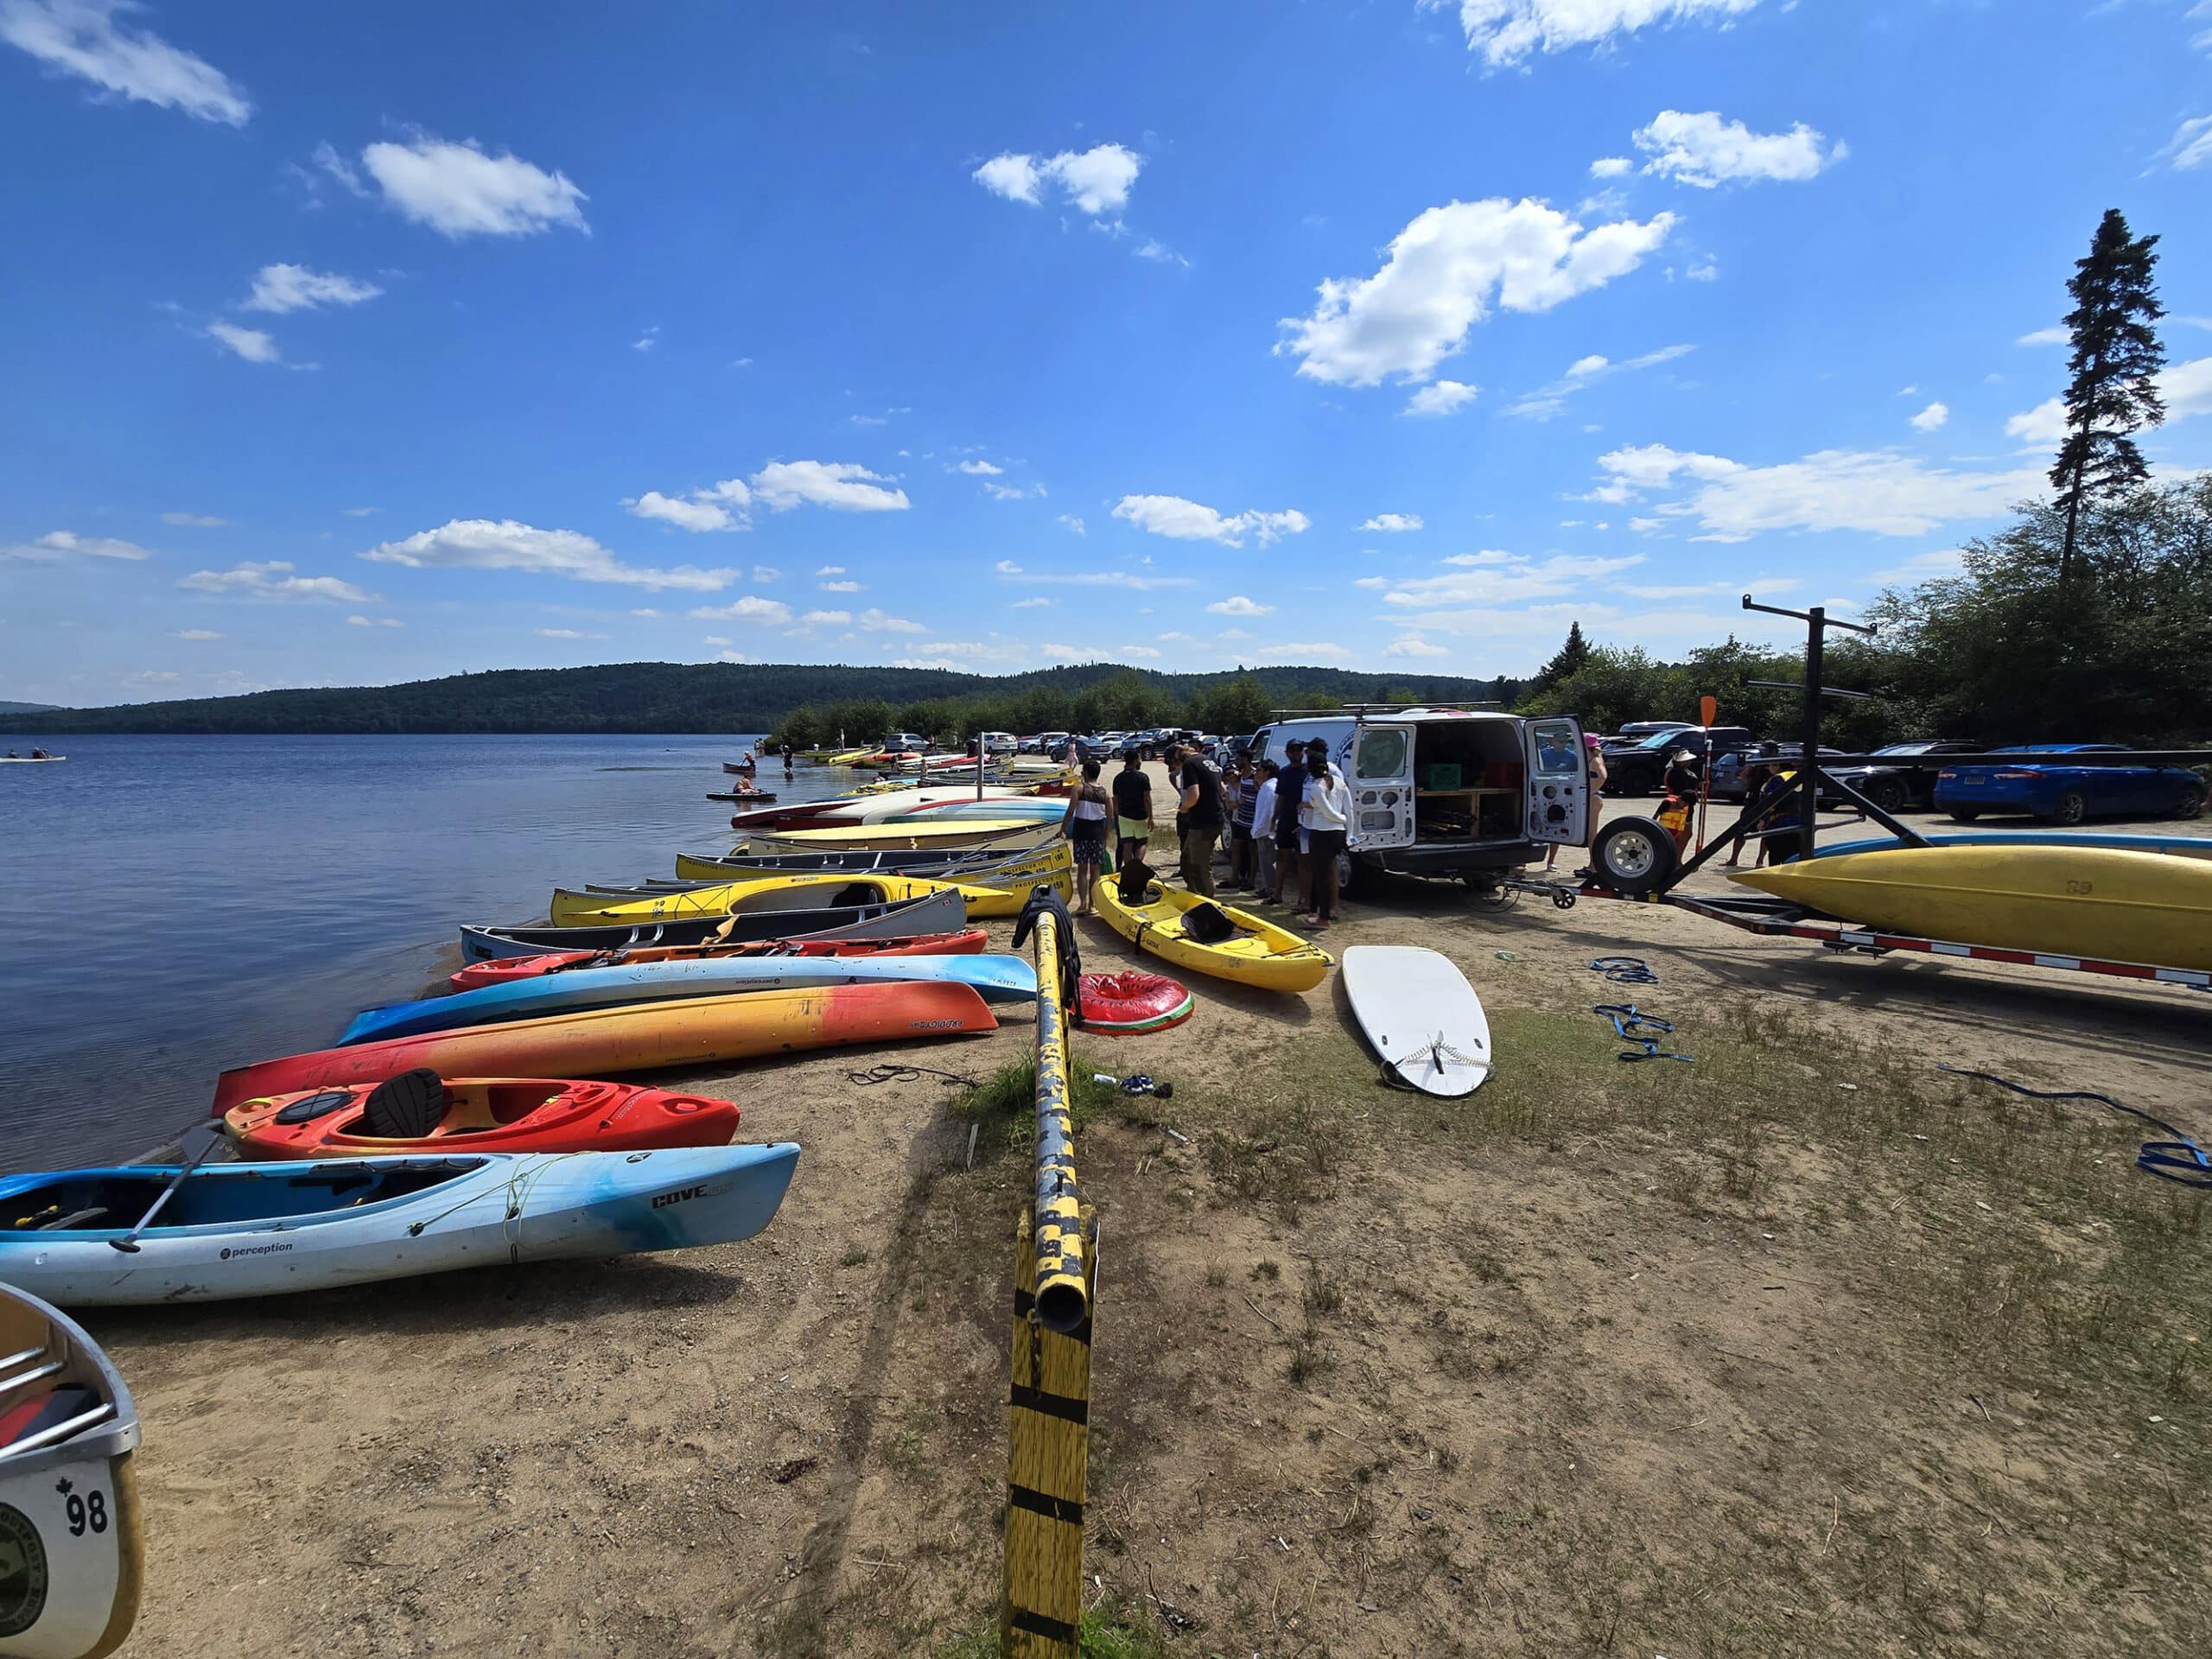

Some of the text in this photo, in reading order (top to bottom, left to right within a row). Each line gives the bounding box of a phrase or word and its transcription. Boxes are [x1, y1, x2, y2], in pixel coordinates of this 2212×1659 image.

[1000, 862, 1037, 874] PROSPECTOR
[1014, 876, 1054, 888] PROSPECTOR
[734, 977, 773, 986] perception
[925, 1019, 963, 1030] PRODIGY
[652, 1184, 709, 1210] COVE
[232, 1243, 293, 1258] perception
[65, 1490, 108, 1537] 98
